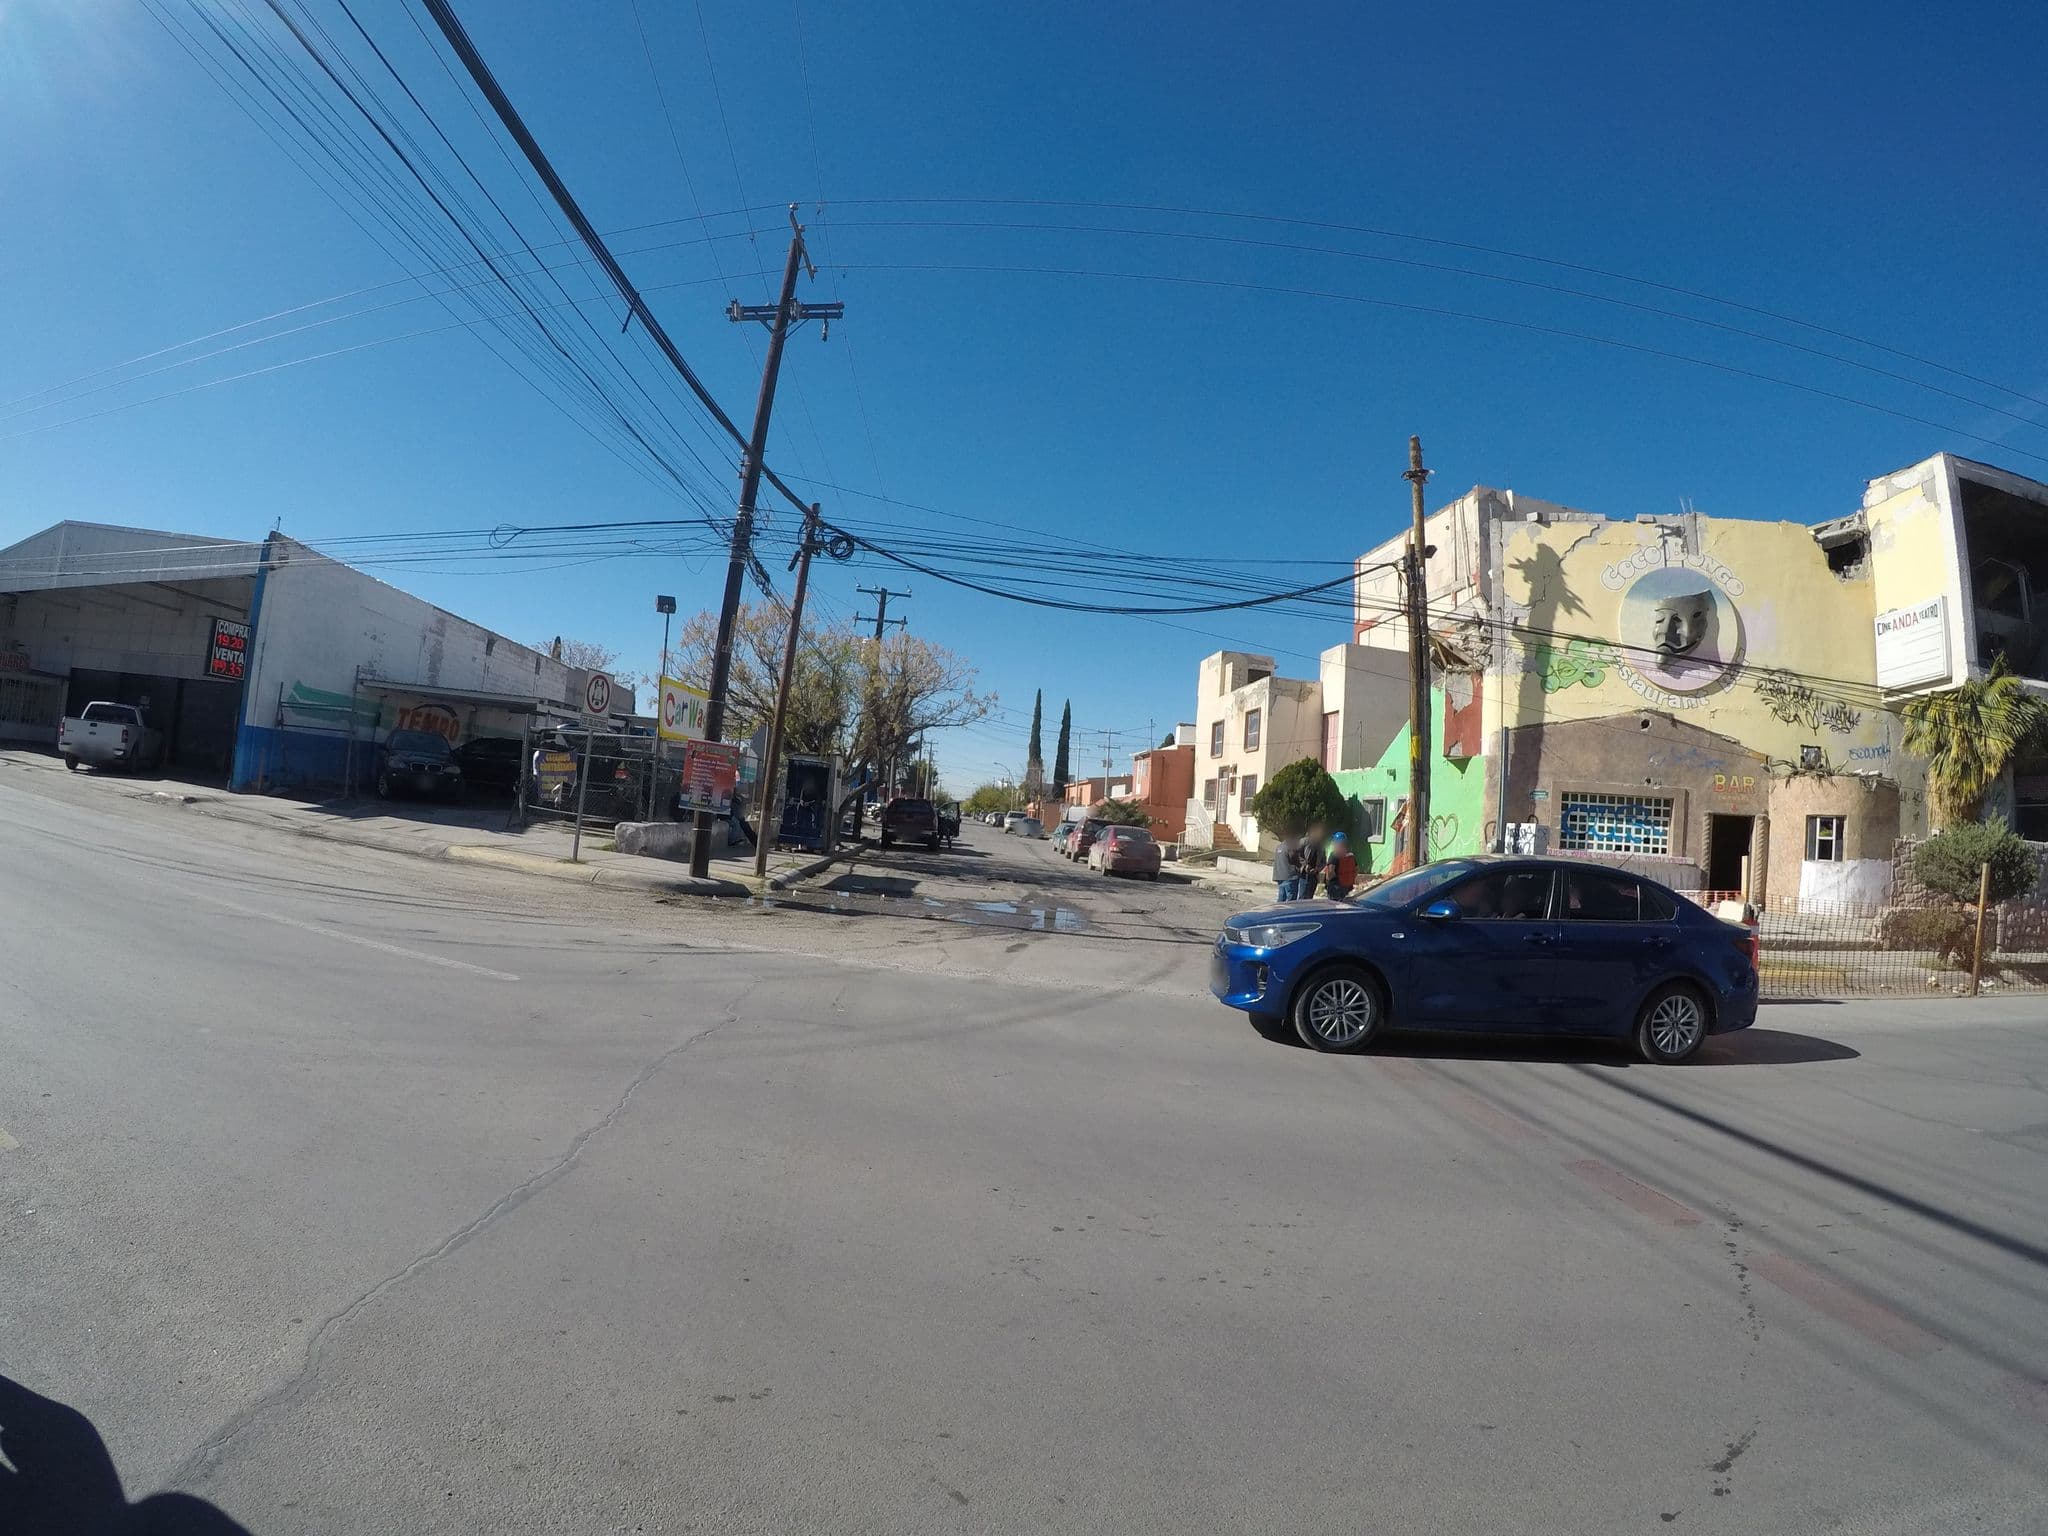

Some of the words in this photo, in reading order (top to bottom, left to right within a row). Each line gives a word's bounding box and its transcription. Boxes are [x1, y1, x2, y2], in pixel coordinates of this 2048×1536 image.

[1893, 611, 1919, 632] ANDA
[1919, 603, 1939, 619] TEATRO
[218, 621, 248, 639] COMPRA
[215, 647, 244, 664] VENTA
[1713, 772, 1756, 794] BAR
